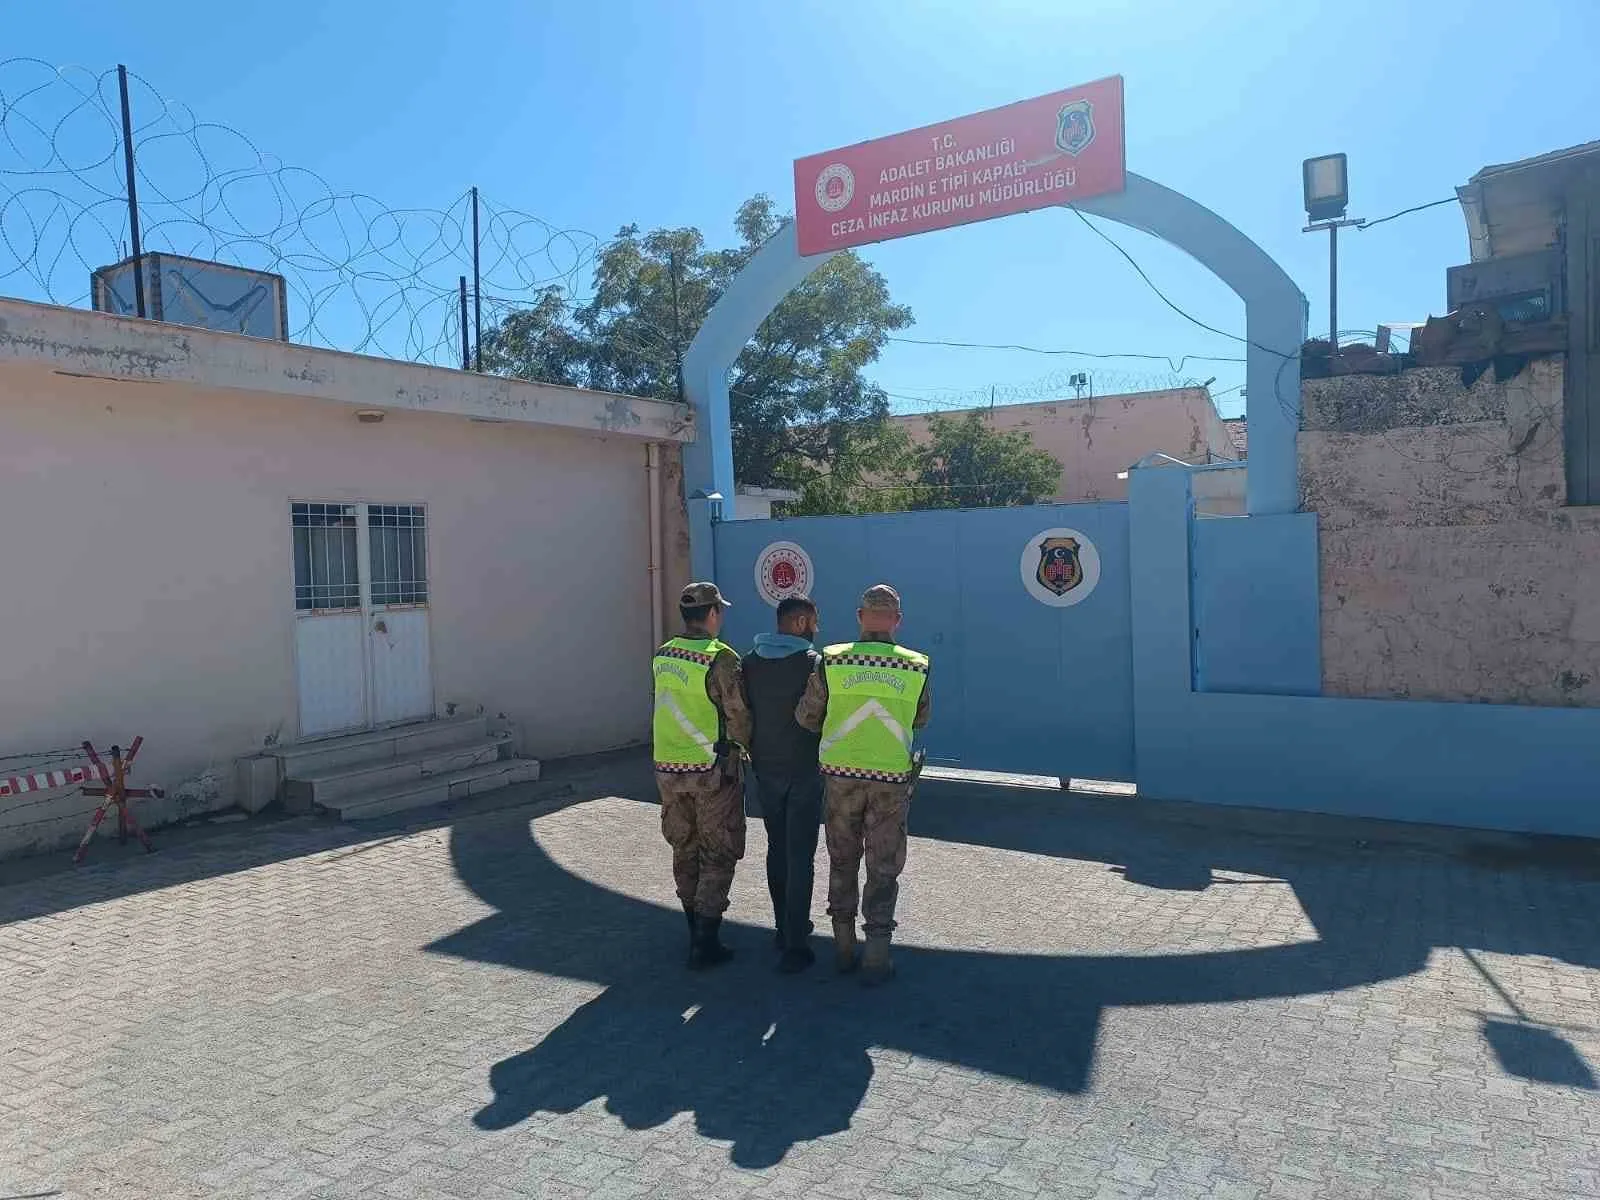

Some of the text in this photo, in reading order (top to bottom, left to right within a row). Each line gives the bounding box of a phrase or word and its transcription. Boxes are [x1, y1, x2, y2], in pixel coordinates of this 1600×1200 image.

[879, 137, 1015, 184] ADALET BAKANLIĞI
[931, 134, 957, 151] T.C.
[831, 167, 1076, 236] CEZA İNFAZ KURUMU MÜDÜRLÜĞÜ
[869, 182, 924, 208] MARDİN
[929, 180, 937, 195] E
[941, 170, 968, 192] TİPİ
